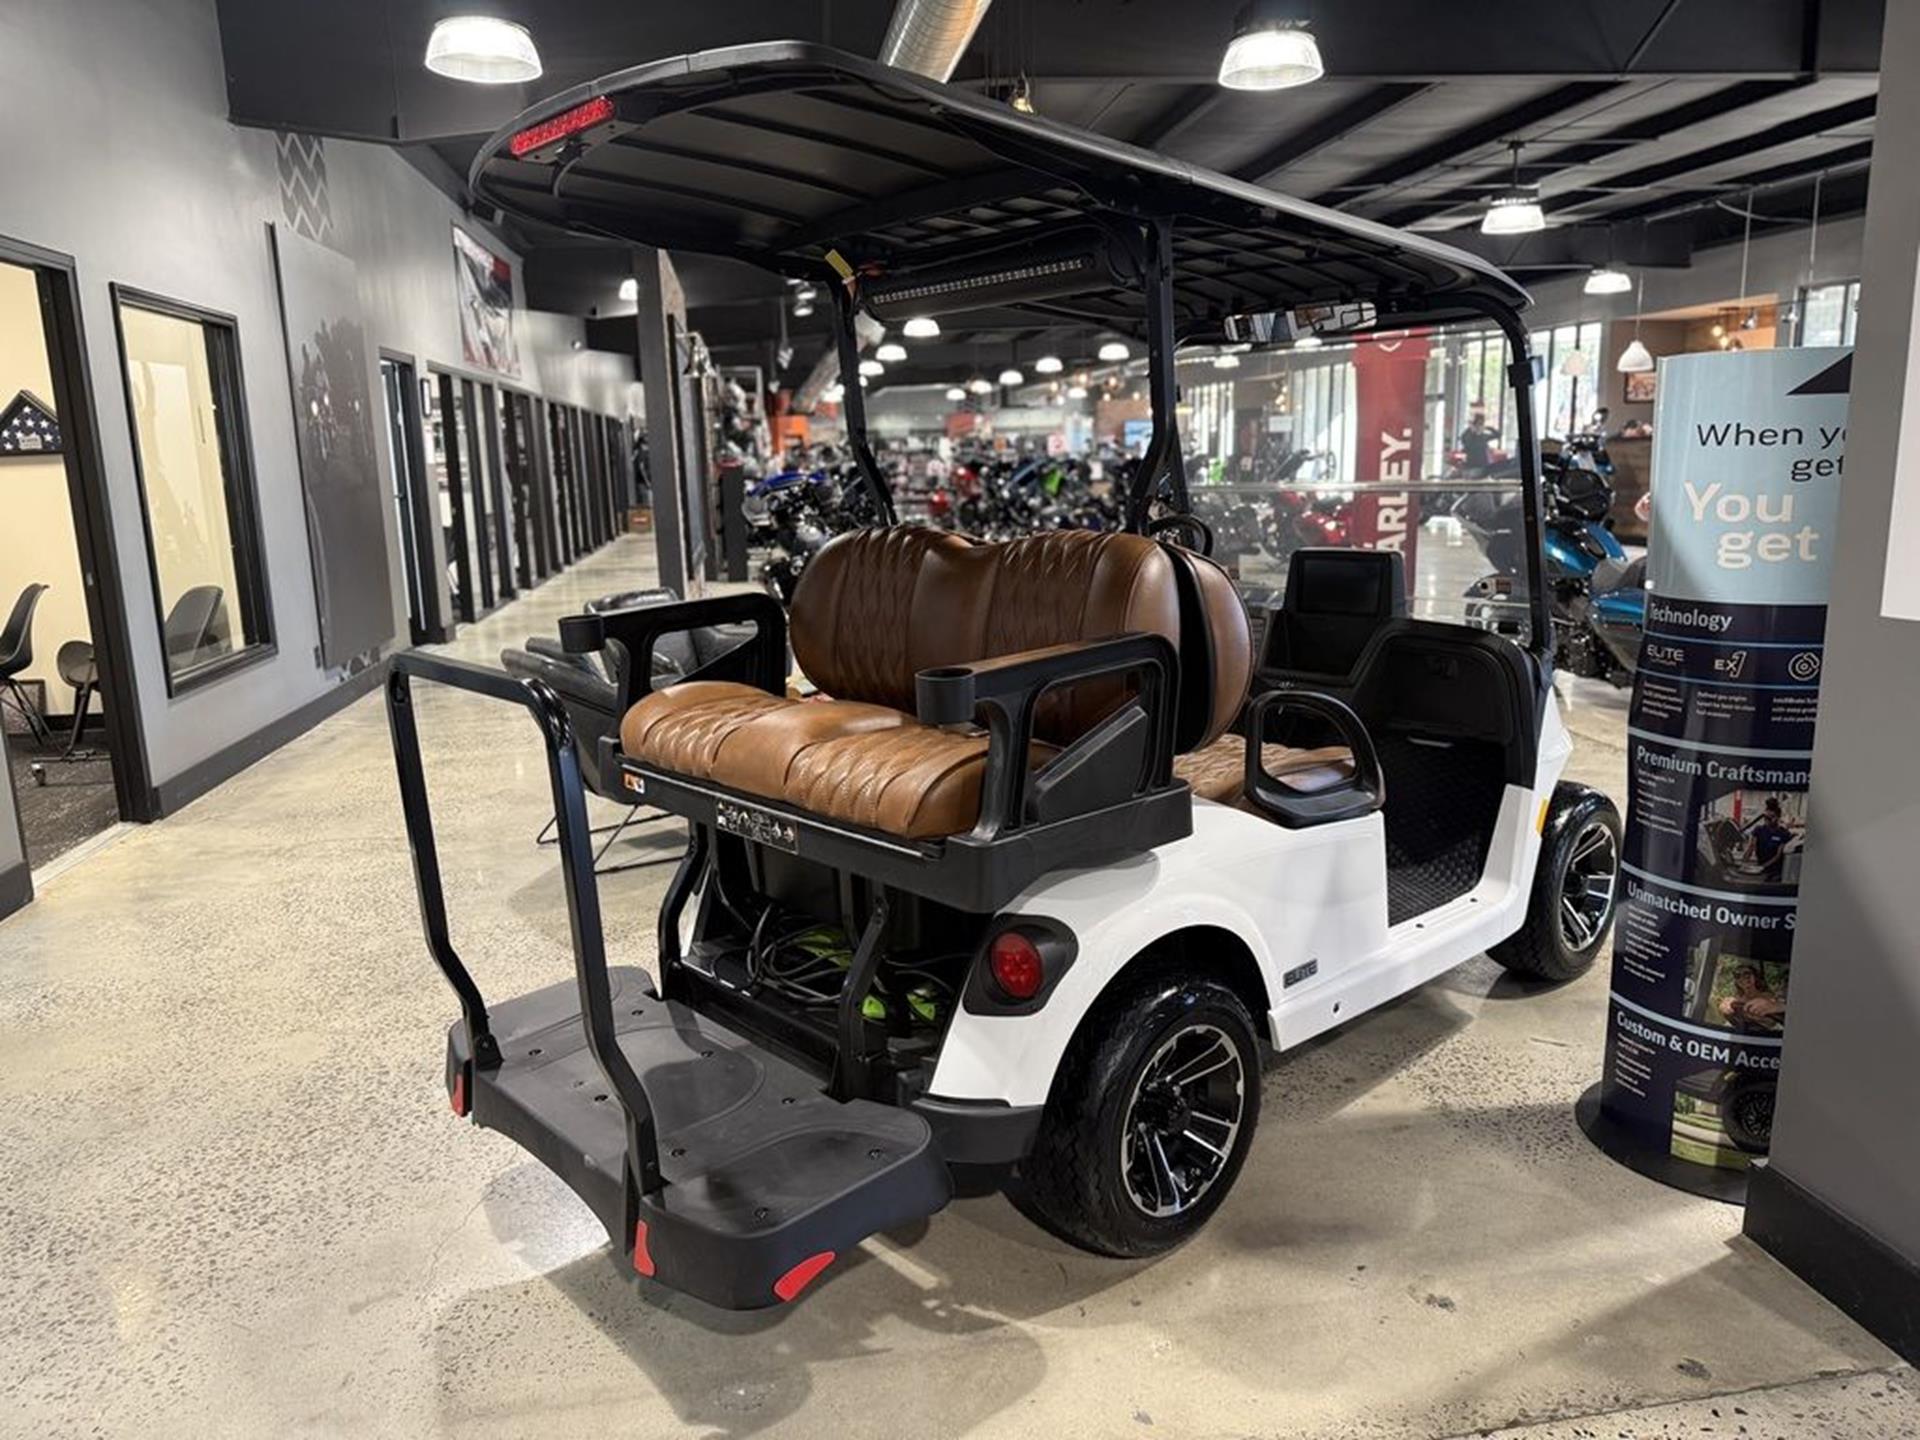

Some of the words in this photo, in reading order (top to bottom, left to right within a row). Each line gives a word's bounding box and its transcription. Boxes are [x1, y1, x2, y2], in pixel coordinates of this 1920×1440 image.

[1697, 423, 1803, 446] When
[1820, 427, 1846, 449] y
[1684, 480, 1794, 524] You
[1717, 526, 1819, 570] get
[1637, 745, 1701, 776] Premium
[1706, 760, 1811, 785] Craftsman
[1627, 880, 1711, 921] Unmatched
[1716, 906, 1779, 929] Owner
[1616, 1011, 1666, 1047] Custom
[1669, 1035, 1683, 1053] &
[1686, 1041, 1730, 1065] OEM
